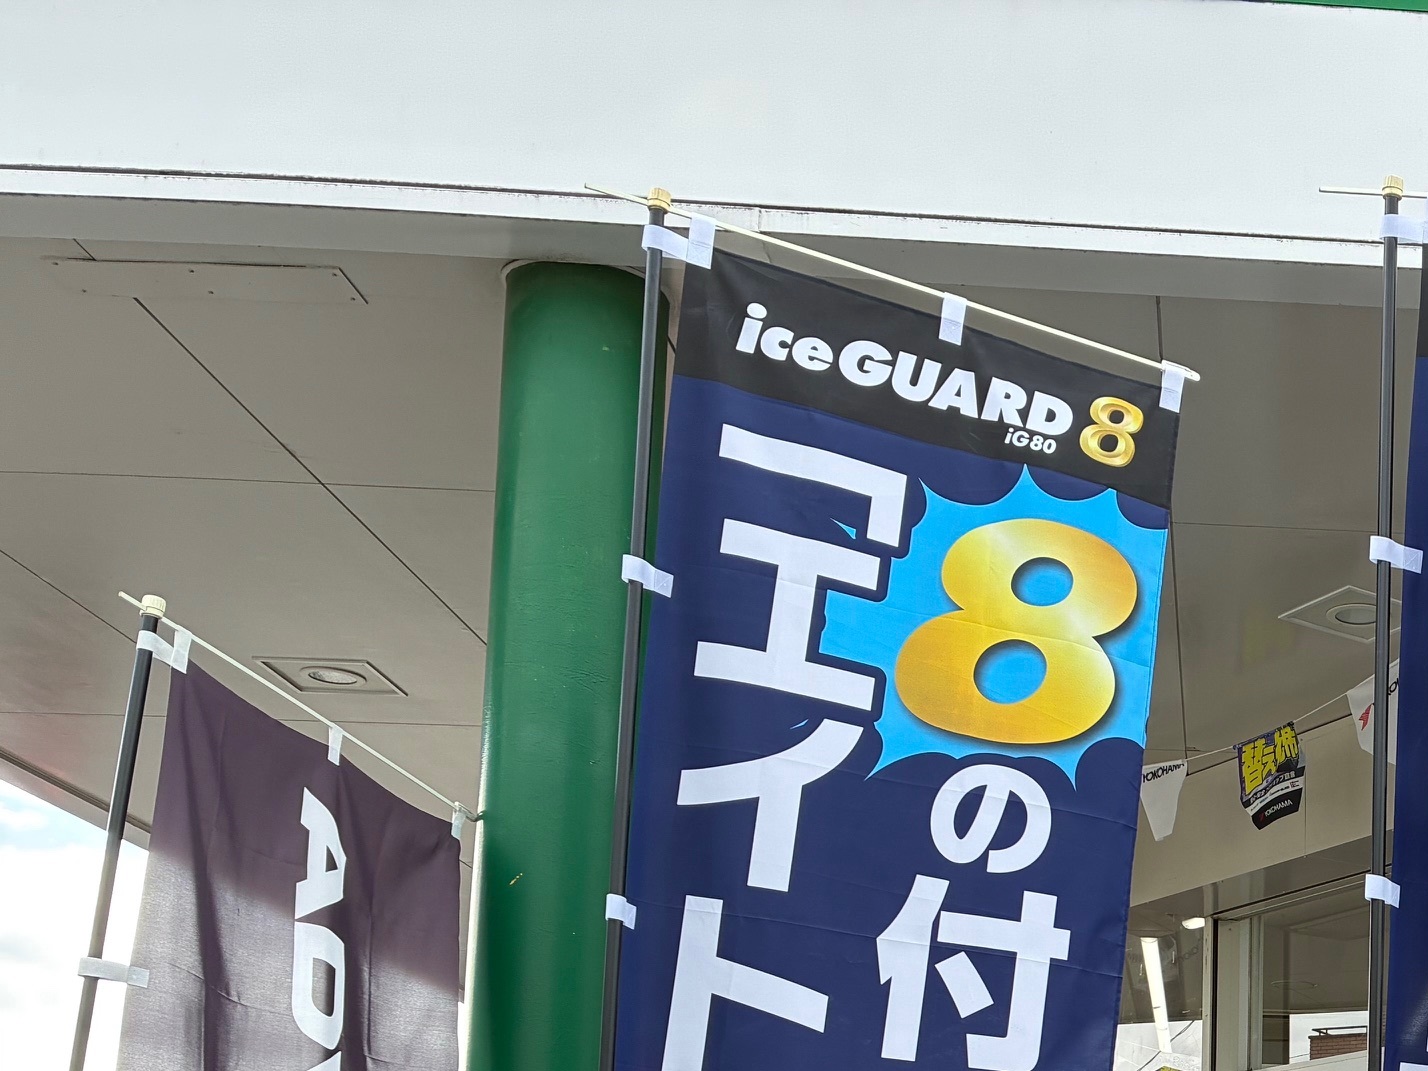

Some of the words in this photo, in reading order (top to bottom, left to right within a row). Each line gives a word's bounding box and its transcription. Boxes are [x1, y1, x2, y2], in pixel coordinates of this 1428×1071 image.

[735, 303, 1074, 436] iceGUARD
[1079, 396, 1144, 468] 8
[1004, 427, 1057, 455] iG80
